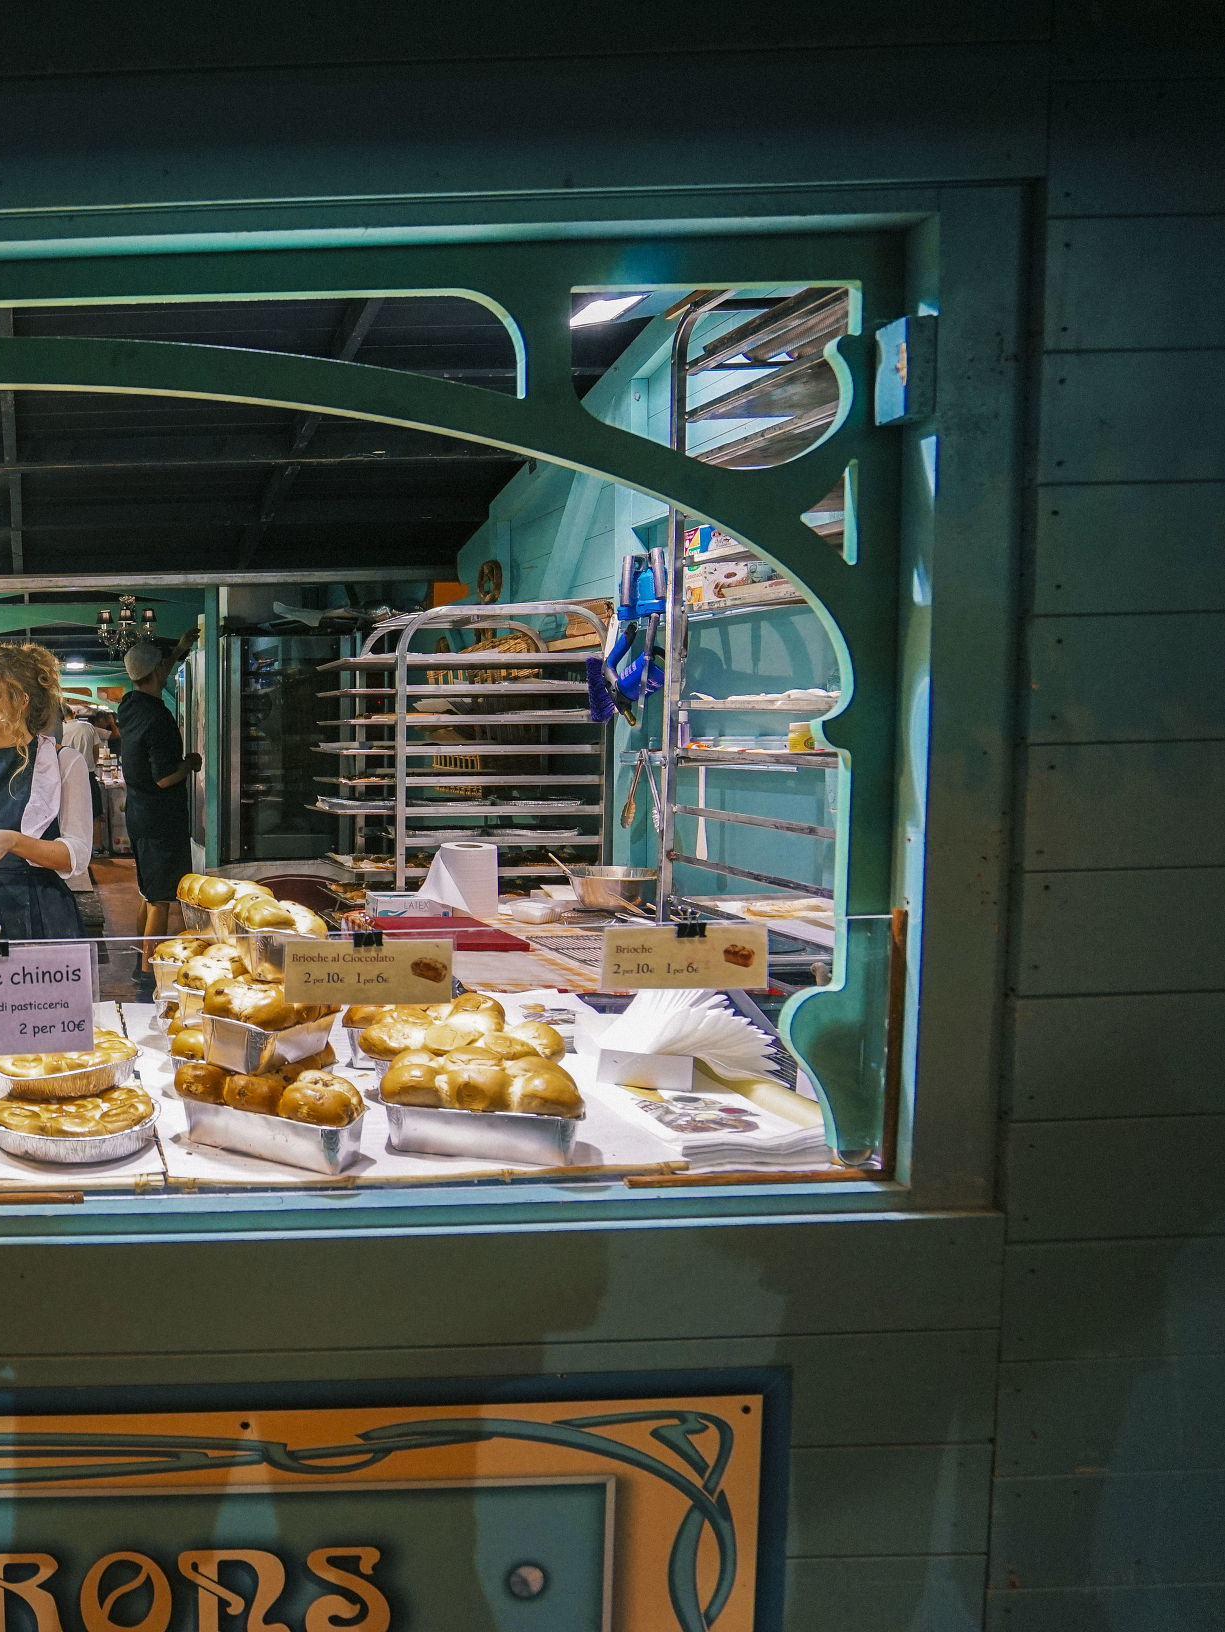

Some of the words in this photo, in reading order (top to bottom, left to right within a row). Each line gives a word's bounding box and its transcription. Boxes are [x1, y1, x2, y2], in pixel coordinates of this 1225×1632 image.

[403, 900, 430, 910] LATEX
[615, 944, 653, 954] Brioche
[292, 953, 329, 963] Brioche
[331, 953, 340, 963] al
[342, 953, 395, 963] Cioccolato
[10, 964, 82, 986] chinois
[612, 963, 621, 975] 2
[622, 968, 635, 976] per
[635, 962, 655, 975] 10€
[665, 962, 672, 974] 1
[673, 968, 684, 976] per
[686, 962, 702, 974] 6€
[304, 972, 312, 984] 2
[326, 972, 345, 984] 10€
[356, 972, 361, 984] 1
[363, 978, 375, 986] per
[376, 972, 390, 984] 6€
[11, 1000, 70, 1014] pasticceria
[19, 1022, 28, 1035] 2
[32, 1023, 56, 1038] per
[60, 1019, 86, 1034] 10€
